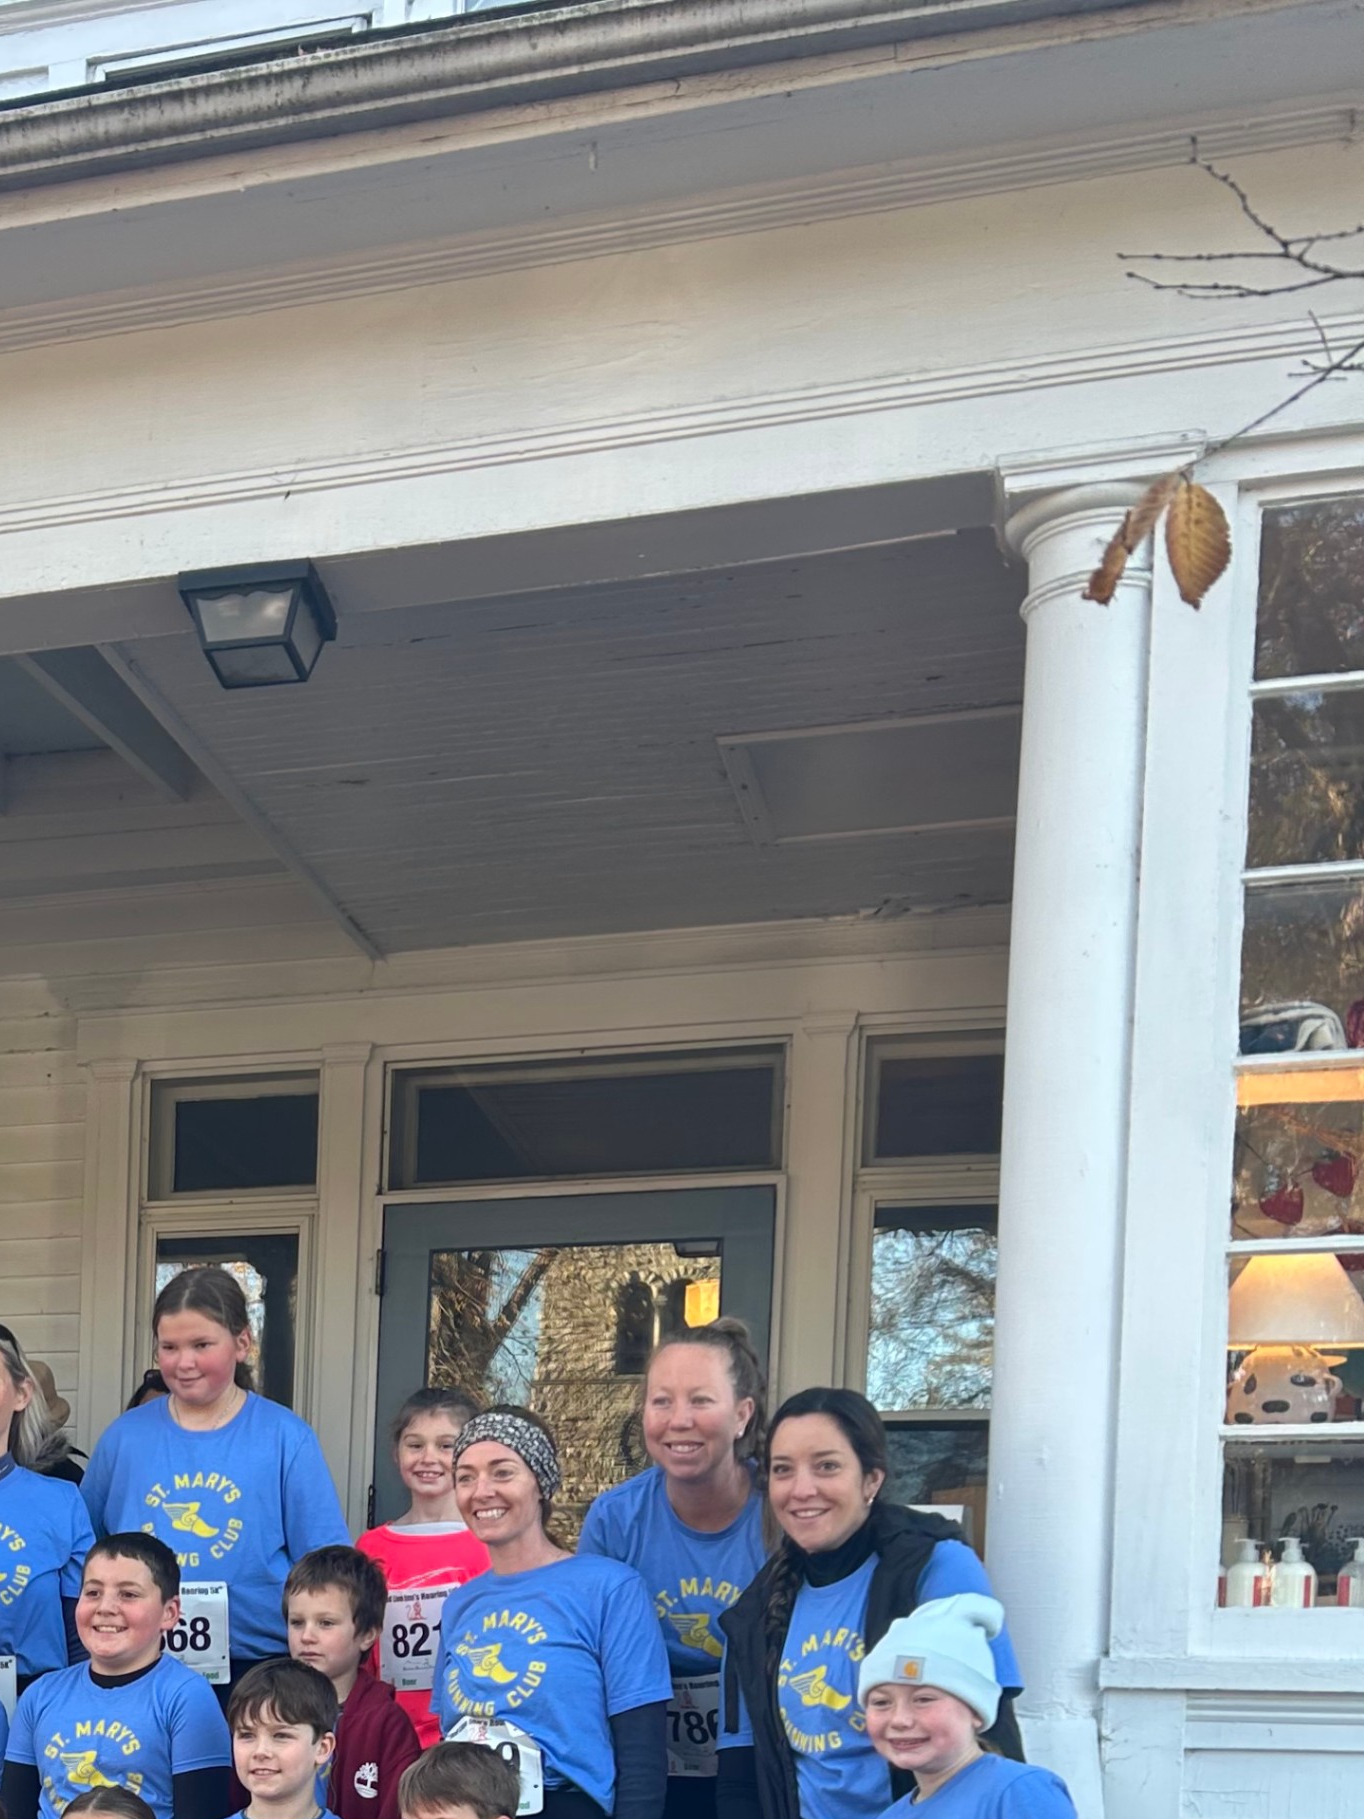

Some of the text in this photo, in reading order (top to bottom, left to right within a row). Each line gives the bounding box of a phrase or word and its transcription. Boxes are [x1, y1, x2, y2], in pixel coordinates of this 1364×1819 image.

[145, 1472, 241, 1508] ST. MARY'S
[210, 1517, 243, 1559] CLUB
[0, 1564, 31, 1605] CLUB
[679, 1577, 741, 1606] MARY
[160, 1617, 212, 1652] 68
[483, 1609, 548, 1645] MARY'S
[448, 1661, 547, 1717] RUNNING CLUB
[849, 1710, 867, 1732] CL
[44, 1719, 141, 1760] ST. MARY'S
